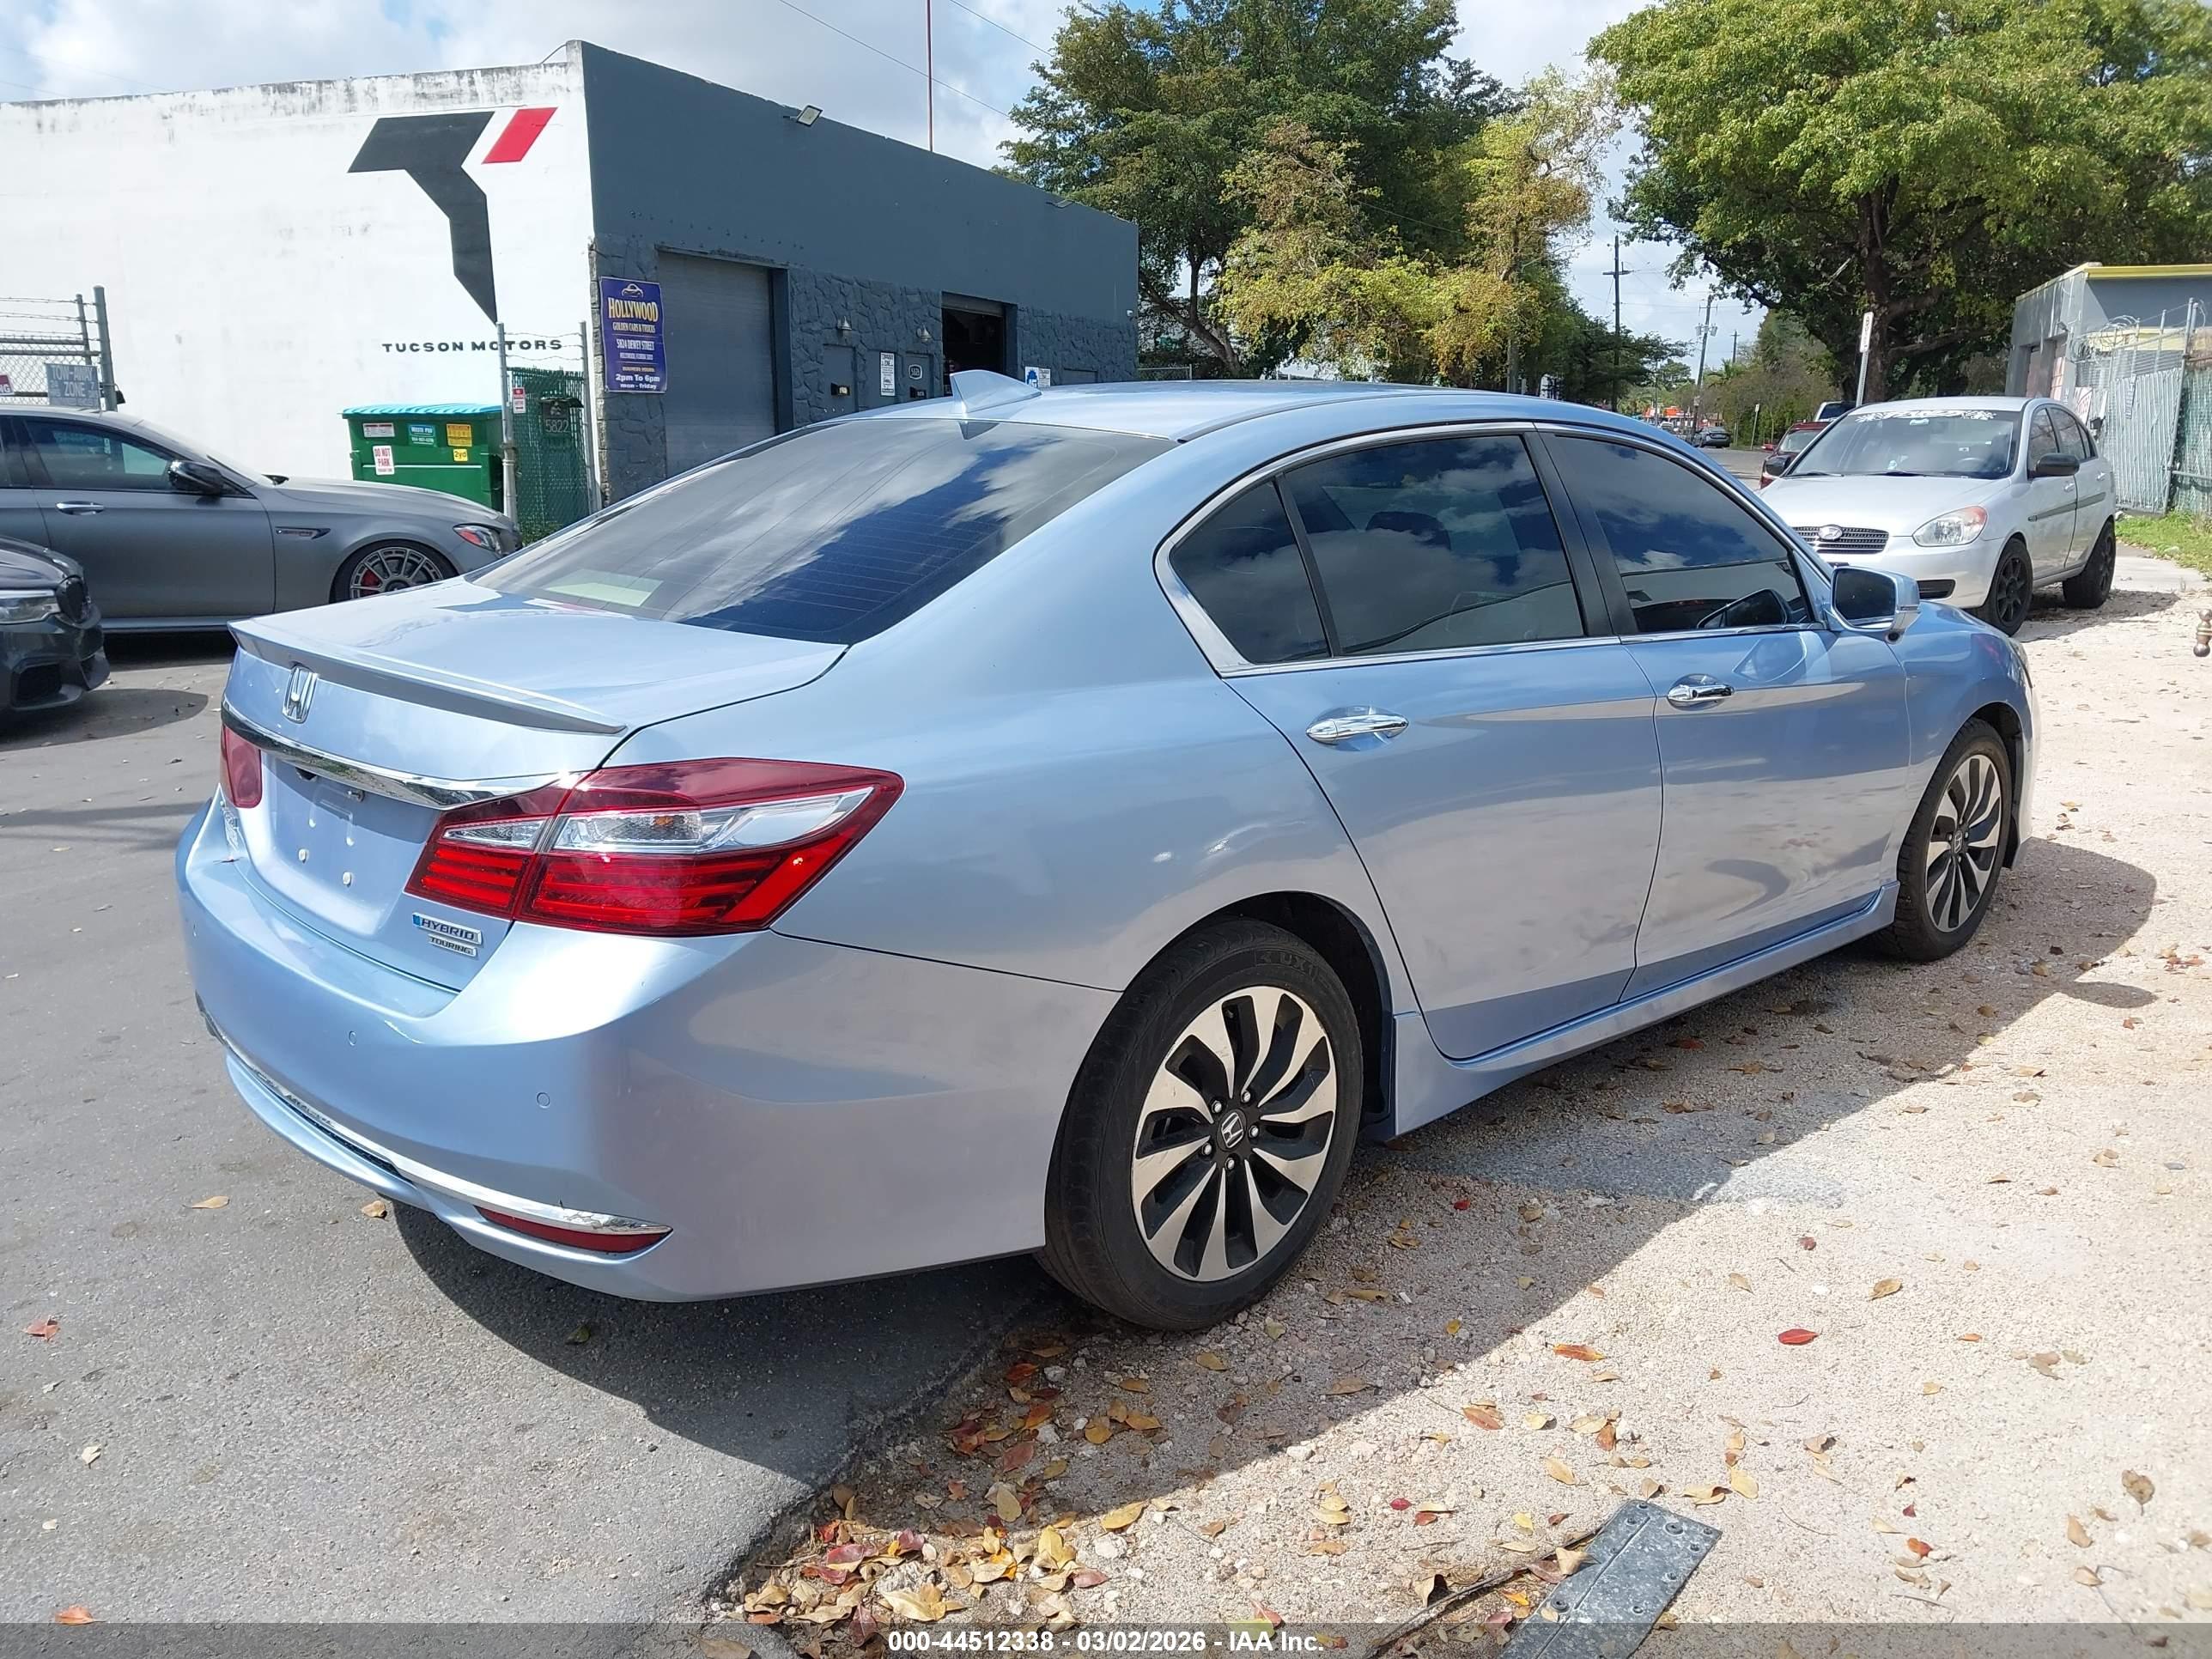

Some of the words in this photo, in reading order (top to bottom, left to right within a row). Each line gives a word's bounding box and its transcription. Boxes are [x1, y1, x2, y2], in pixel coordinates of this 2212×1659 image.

[607, 297, 659, 323] HOLLYWOOD
[382, 341, 464, 353] TUCSON
[471, 339, 563, 351] MOTORS
[52, 364, 93, 381] TOW-AWAY
[615, 373, 634, 383] 2pm
[634, 374, 644, 382] To
[644, 374, 660, 384] 6pm
[63, 380, 86, 398] ZONE
[545, 419, 570, 433] 5822
[374, 447, 381, 458] DO
[381, 447, 391, 457] NOT
[377, 458, 391, 467] PARK
[421, 918, 475, 941] HYBRID
[430, 937, 472, 955] TOURING
